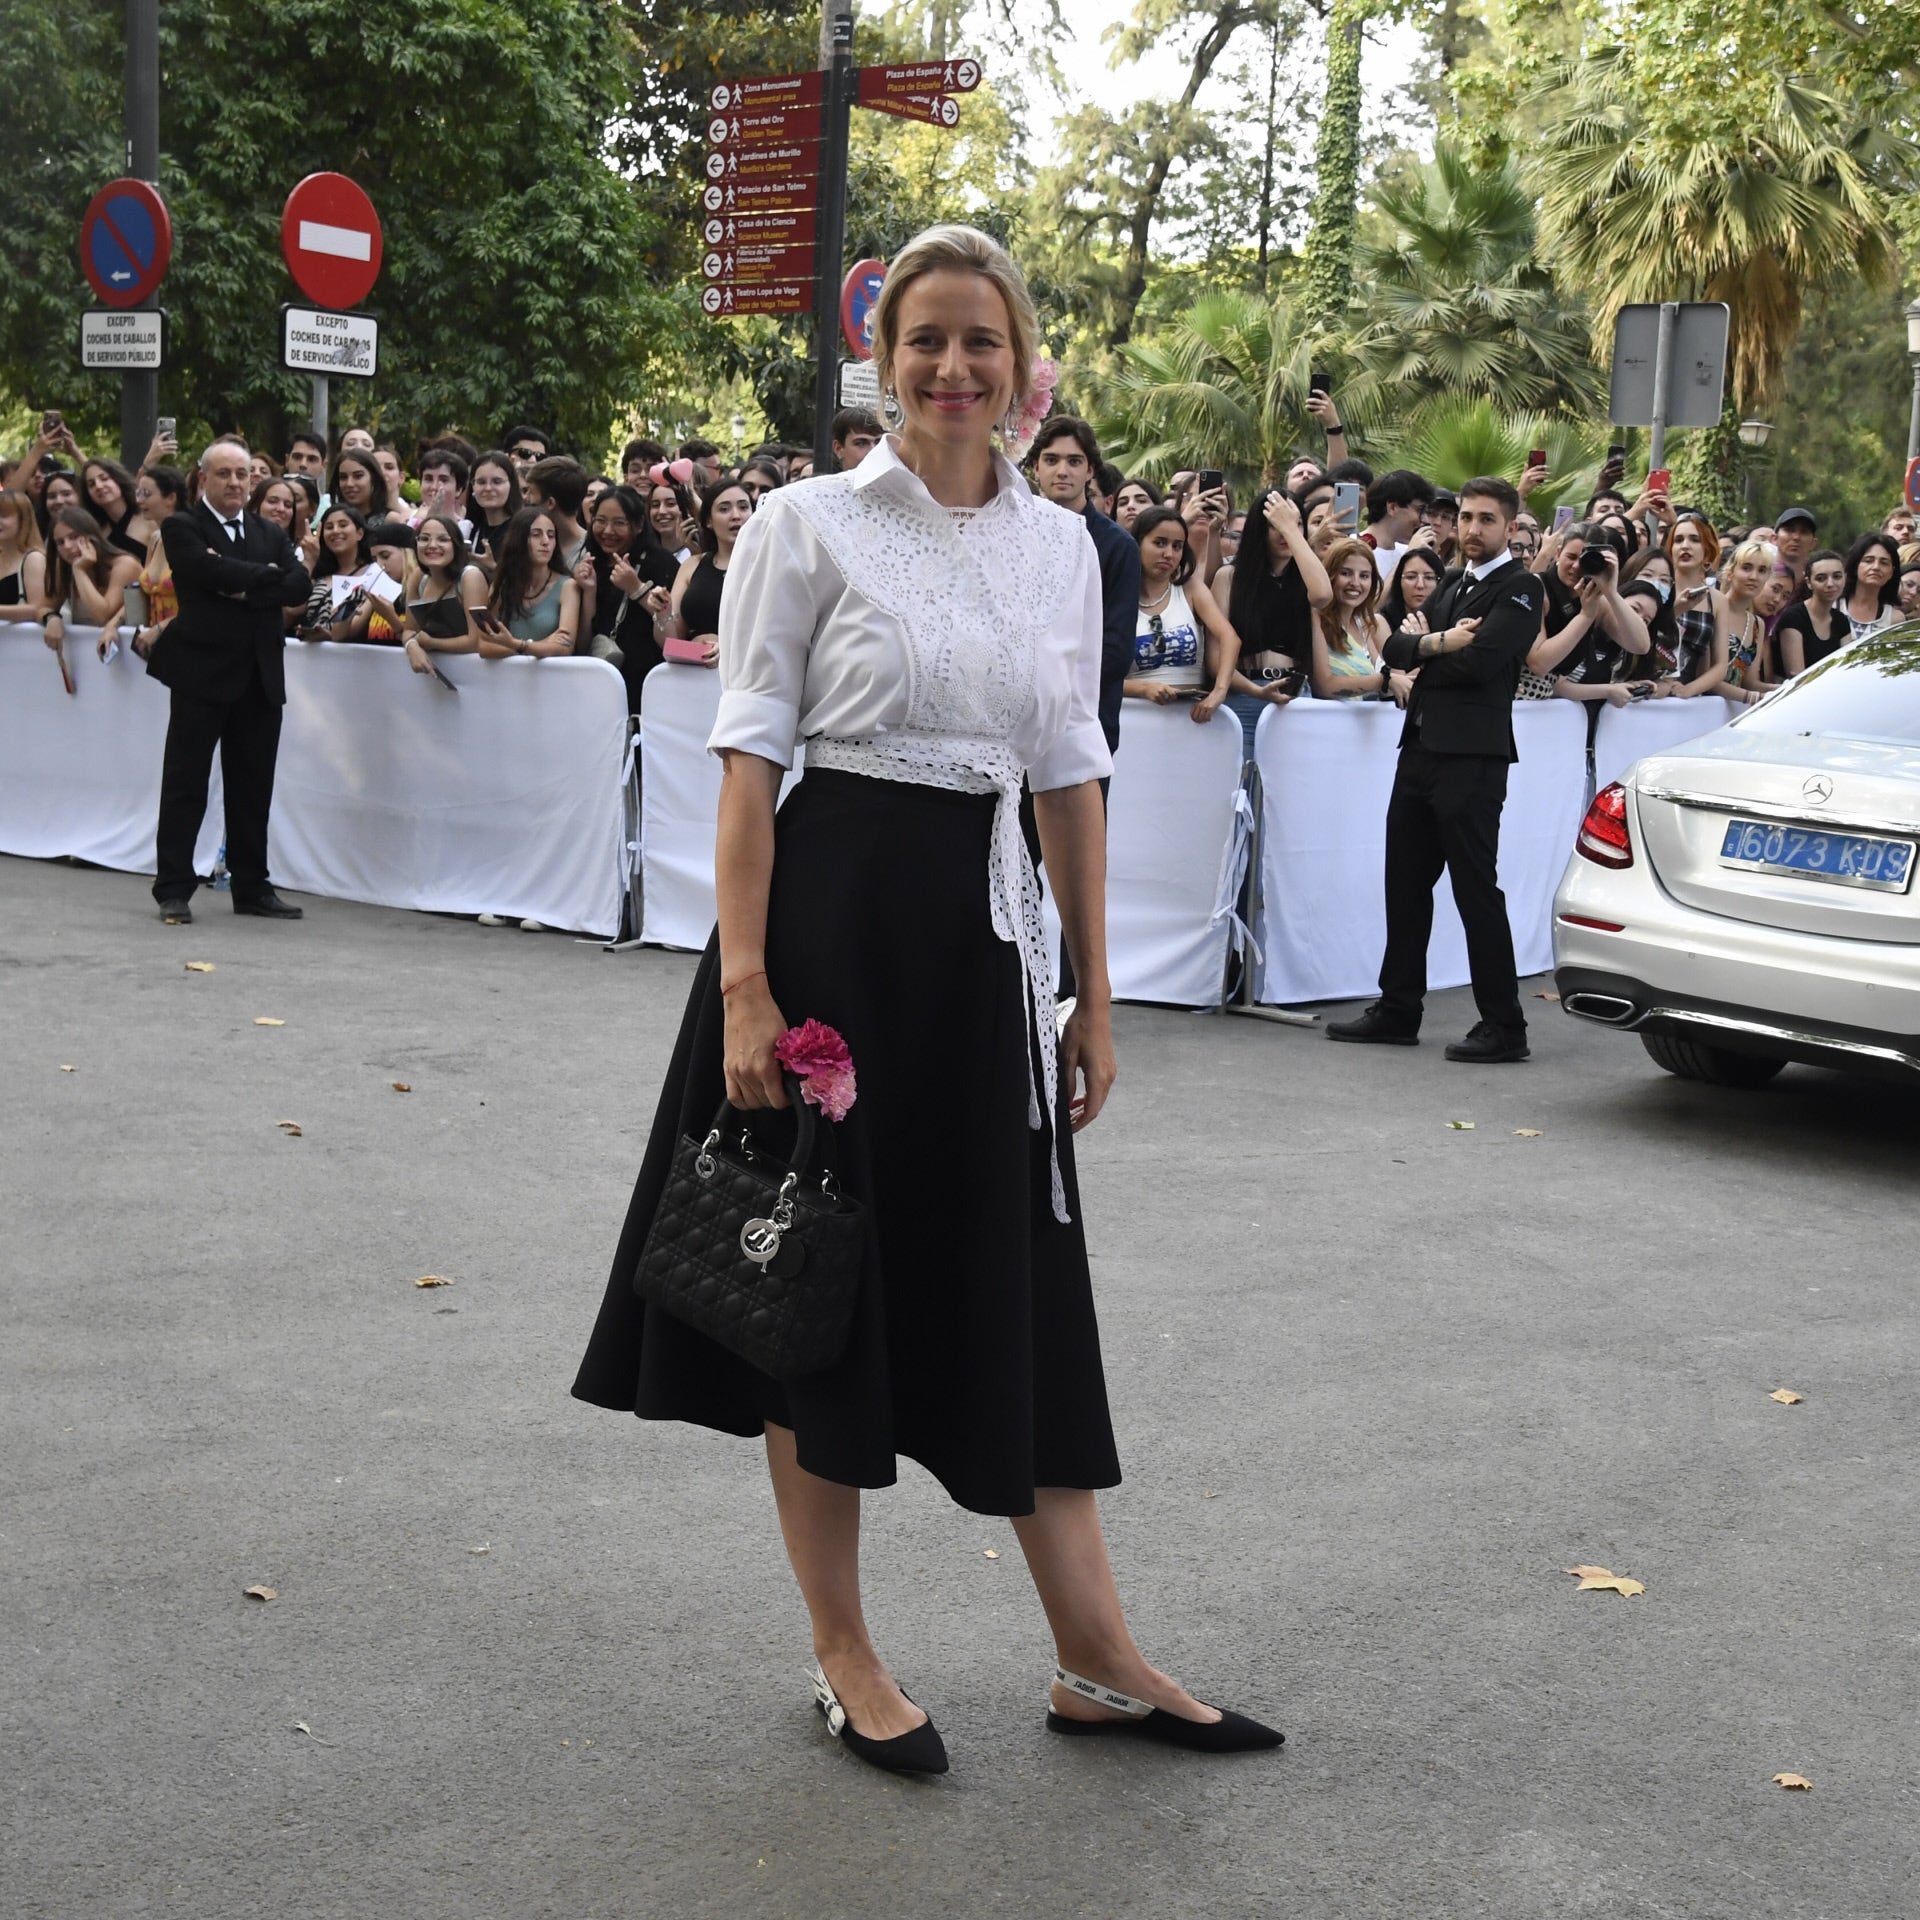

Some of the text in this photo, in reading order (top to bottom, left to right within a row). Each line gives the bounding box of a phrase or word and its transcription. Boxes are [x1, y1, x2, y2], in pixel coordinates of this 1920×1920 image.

[886, 67, 942, 79] Plaza de España
[744, 79, 802, 93] Zona Monumental
[742, 115, 784, 126] Torre del Oro
[740, 153, 768, 161] Jardines
[778, 149, 802, 158] Murillo
[738, 183, 806, 194] Palacio de San Telmo
[738, 217, 796, 228] Casa de la Ciencia
[736, 288, 756, 297] Teatro
[756, 288, 773, 298] Lope
[784, 286, 800, 296] Vega
[106, 316, 136, 328] EXCEPTO
[316, 315, 348, 330] EXCEPTO
[86, 332, 156, 344] COCHES DE CABALLOS
[290, 330, 320, 344] COCHES
[322, 334, 332, 346] DE
[87, 352, 96, 362] DE
[97, 351, 127, 362] SERVICIO
[290, 350, 302, 360] DE
[1743, 826, 1829, 868] 6073
